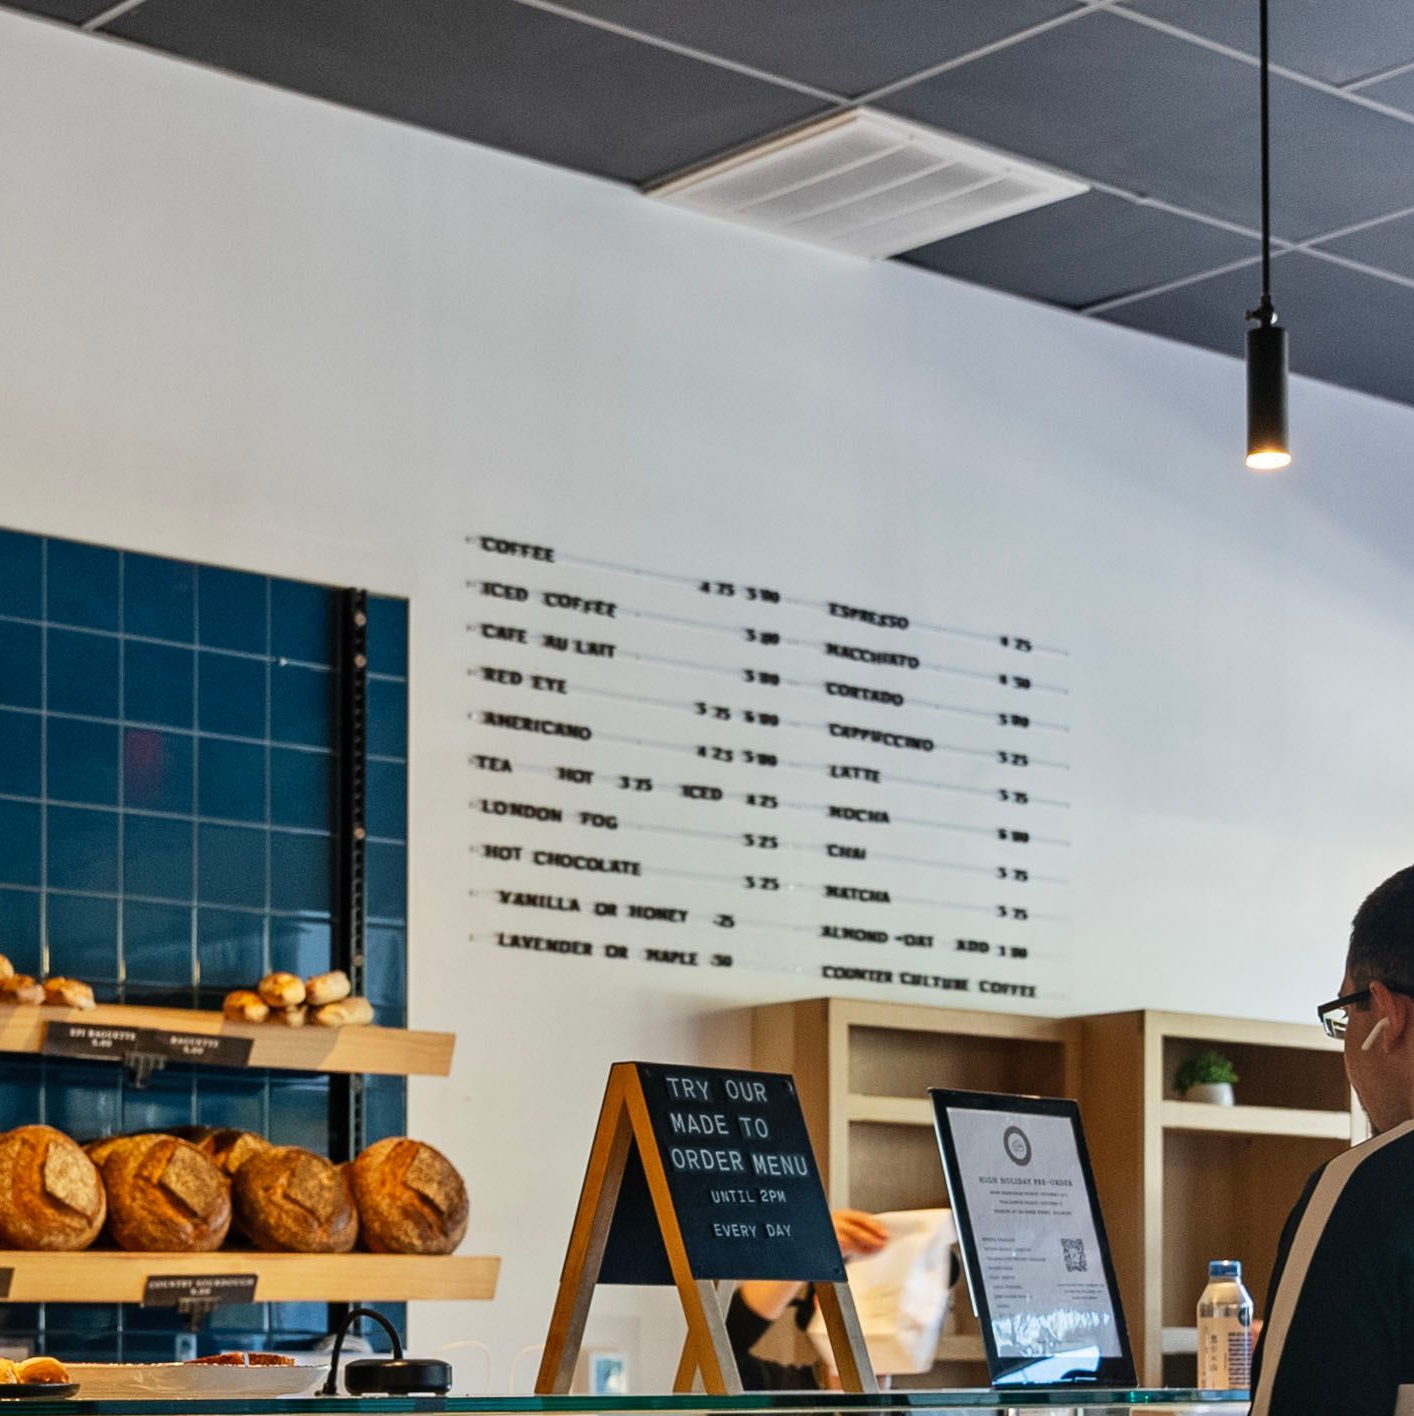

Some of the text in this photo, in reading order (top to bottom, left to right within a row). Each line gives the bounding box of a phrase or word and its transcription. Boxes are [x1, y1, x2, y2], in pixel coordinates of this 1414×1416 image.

[480, 536, 555, 563] COFFEE
[481, 582, 617, 618] ICED COFFEE
[828, 602, 909, 629] ESPRESSO
[481, 624, 616, 658] CAFE AU LAIT
[825, 642, 920, 669] MACCHIATO
[481, 667, 567, 694] RED EYE
[825, 681, 904, 706] CORTADO
[482, 712, 592, 741] AMERICANO
[828, 723, 934, 752] CAPPUCCINO
[474, 755, 722, 801] TEA HOT ICED
[828, 765, 880, 783] LATTE
[480, 800, 618, 829] LONDON FOG
[828, 805, 890, 823] MOCHA
[483, 845, 641, 876] HOT CHOCOLATE
[826, 844, 866, 860] CHAI
[497, 890, 687, 923] VANILLA OR HONEY
[825, 885, 891, 903] MATCHA
[496, 933, 698, 966] LAVENDER OR MAPLE
[820, 925, 888, 943] ALMOND
[956, 938, 989, 953] ADD
[821, 965, 1036, 998] COUNTER CULTURE COFFEE
[666, 1077, 767, 1102] TRY OUR
[670, 1112, 769, 1138] MADE TO
[671, 1148, 808, 1176] ORDER MENU
[711, 1189, 787, 1204] UNTIL 2PM
[713, 1223, 791, 1237] EVERY DAY
